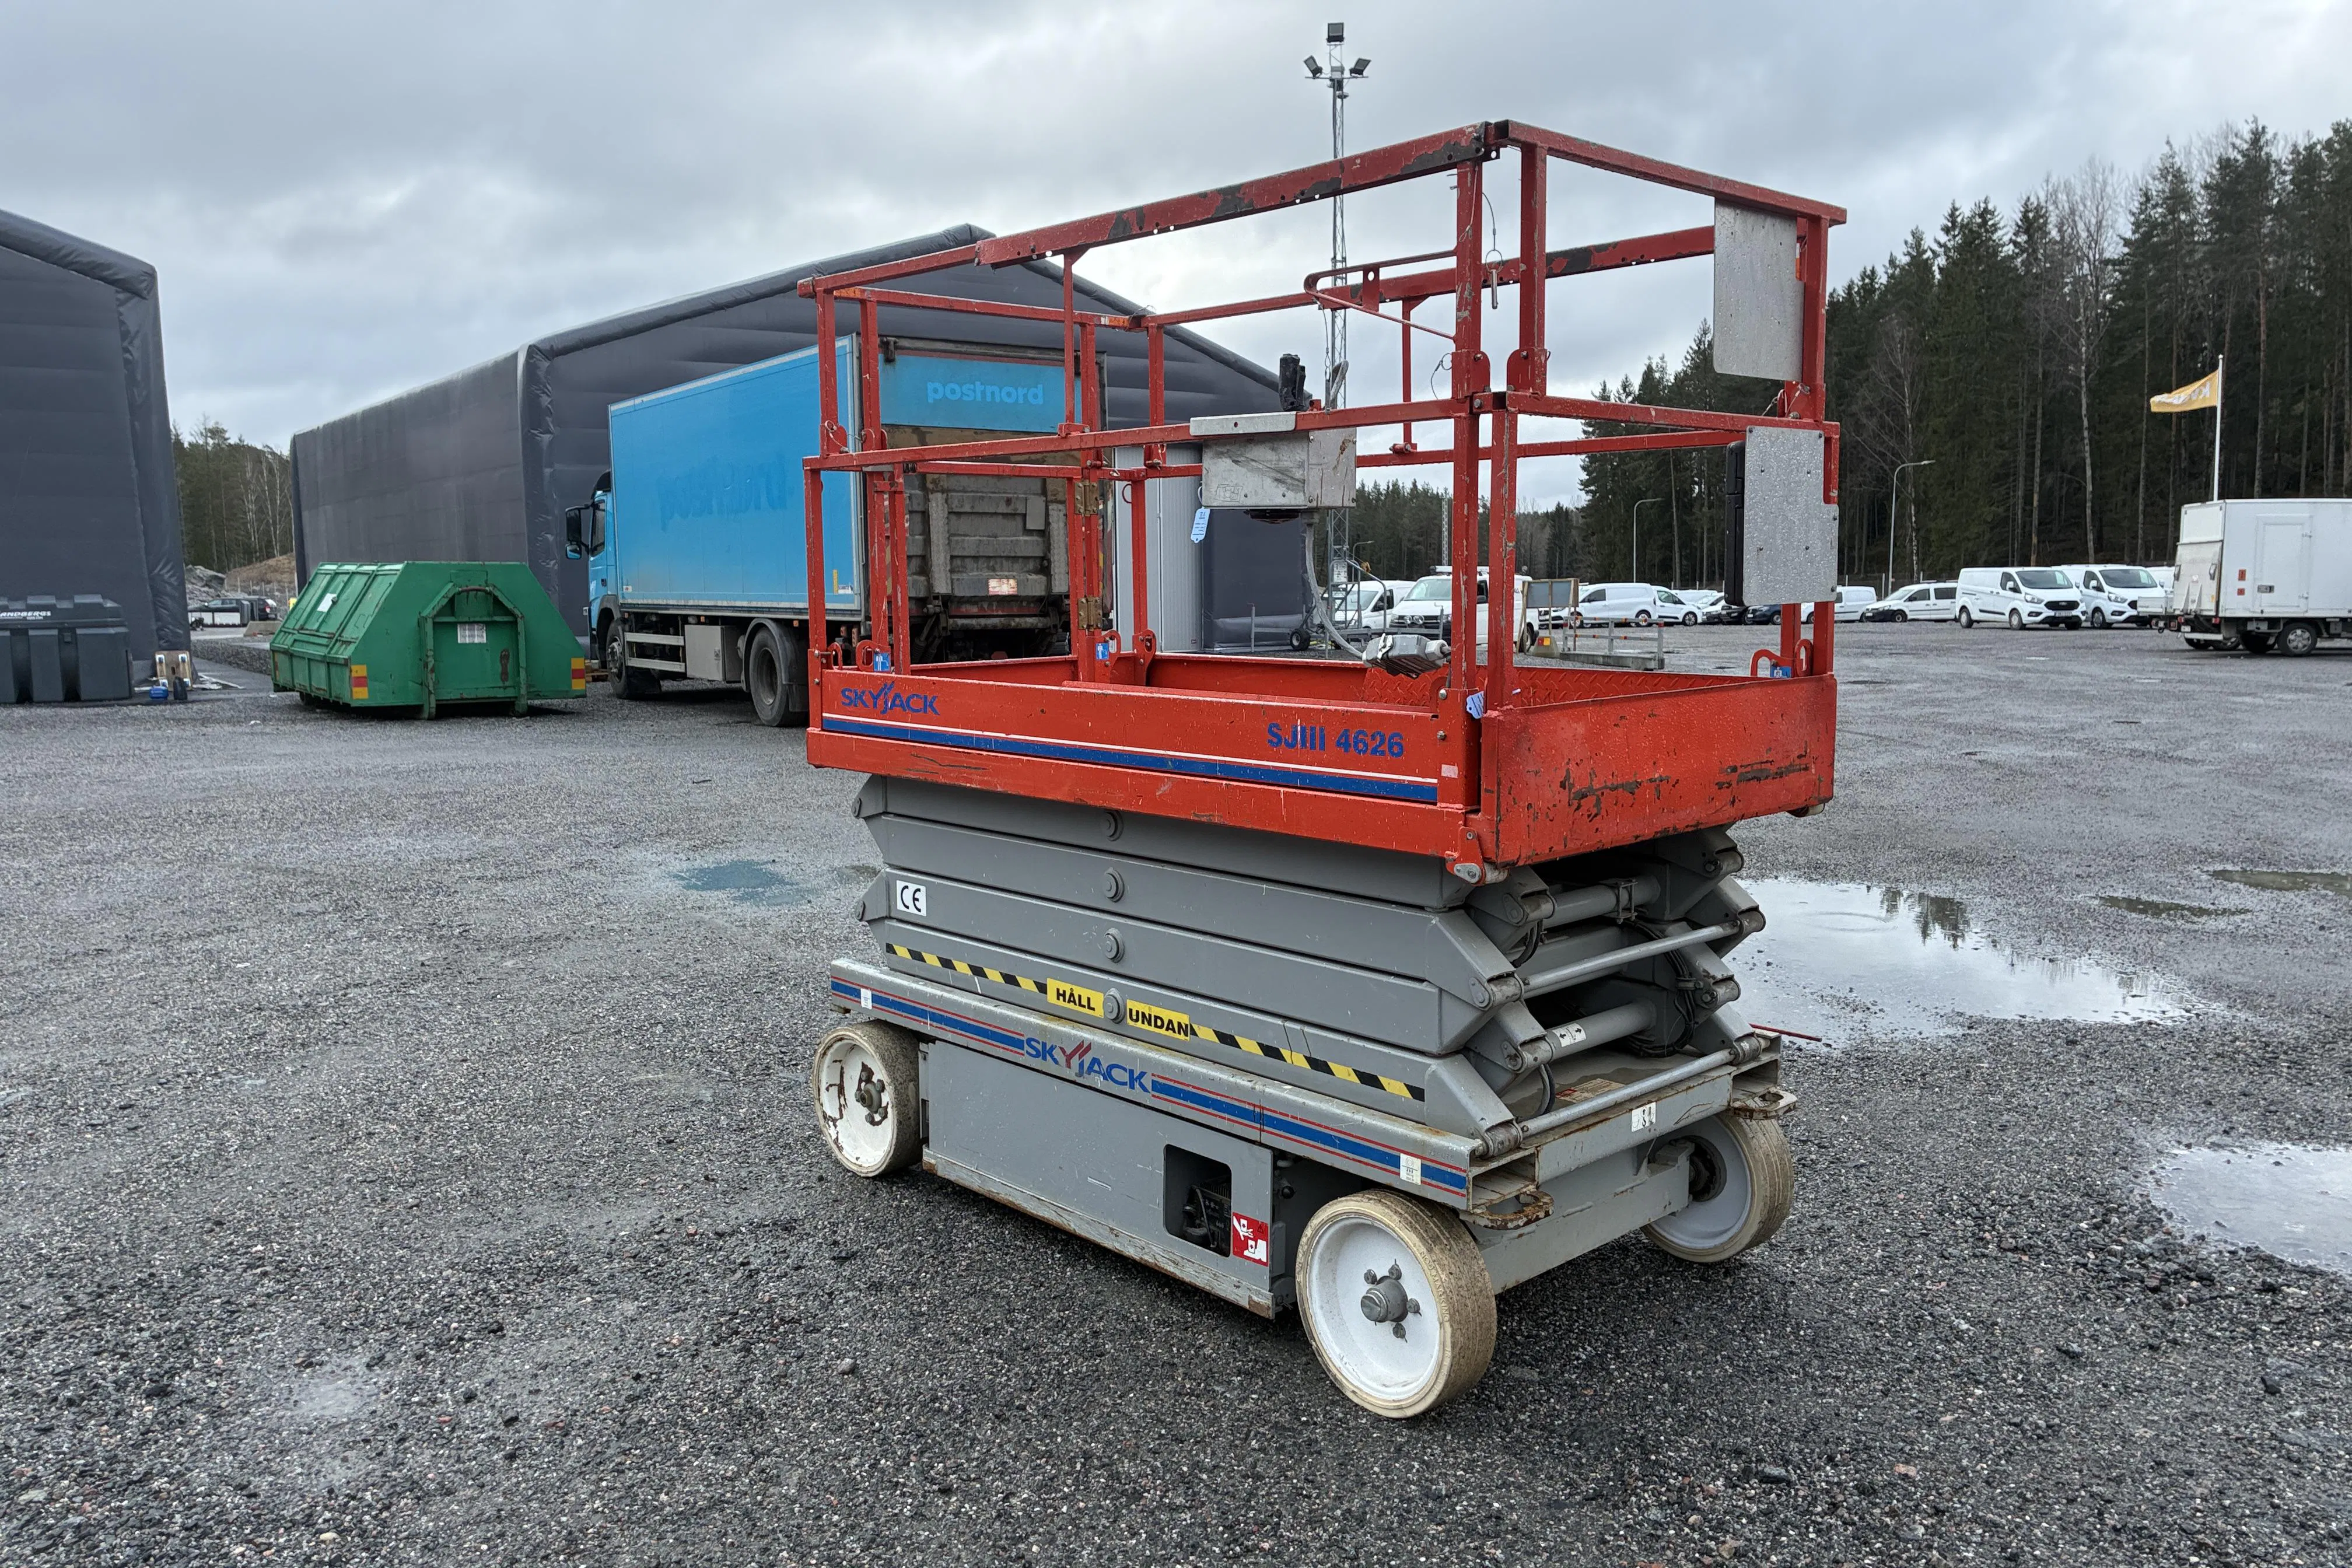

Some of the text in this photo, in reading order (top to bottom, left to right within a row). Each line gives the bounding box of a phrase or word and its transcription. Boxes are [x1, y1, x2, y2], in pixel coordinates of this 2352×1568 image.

[927, 381, 1043, 405] postnord
[841, 681, 940, 715] SKYJACK
[1335, 729, 1404, 758] 4626
[901, 885, 921, 912] CE
[1056, 988, 1189, 1037] HÅLL UNDAN
[1026, 1040, 1151, 1093] SKYJACK
